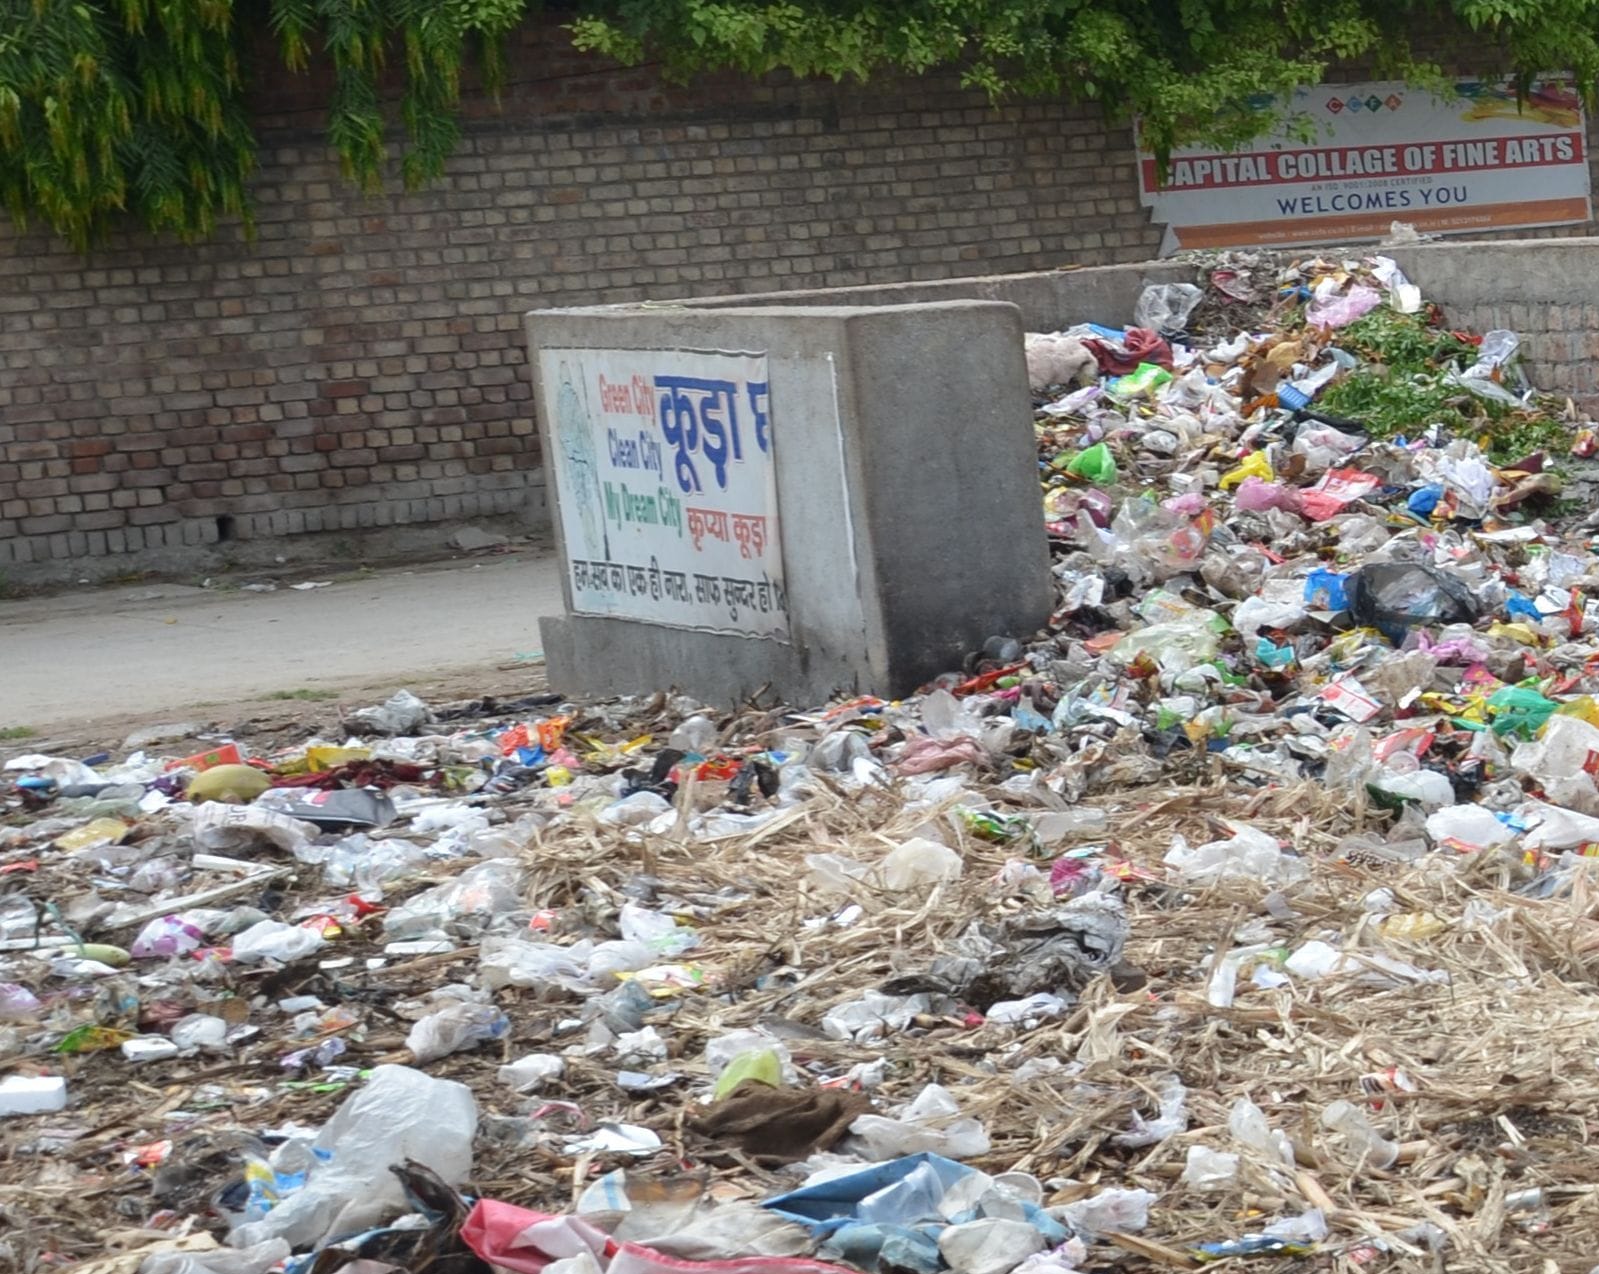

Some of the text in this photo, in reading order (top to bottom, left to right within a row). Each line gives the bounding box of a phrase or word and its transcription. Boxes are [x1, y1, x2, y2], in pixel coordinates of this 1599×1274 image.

[1277, 148, 1397, 180] COLLAGE
[1403, 145, 1436, 171] OF
[1442, 141, 1499, 168] FINE
[1505, 136, 1573, 164] ARTS
[1277, 186, 1468, 215] WELCOMES YOU
[599, 373, 656, 426] Green City
[608, 428, 663, 481] Clean City
[654, 376, 743, 494] कूड़ा
[603, 481, 683, 538] My Dream City
